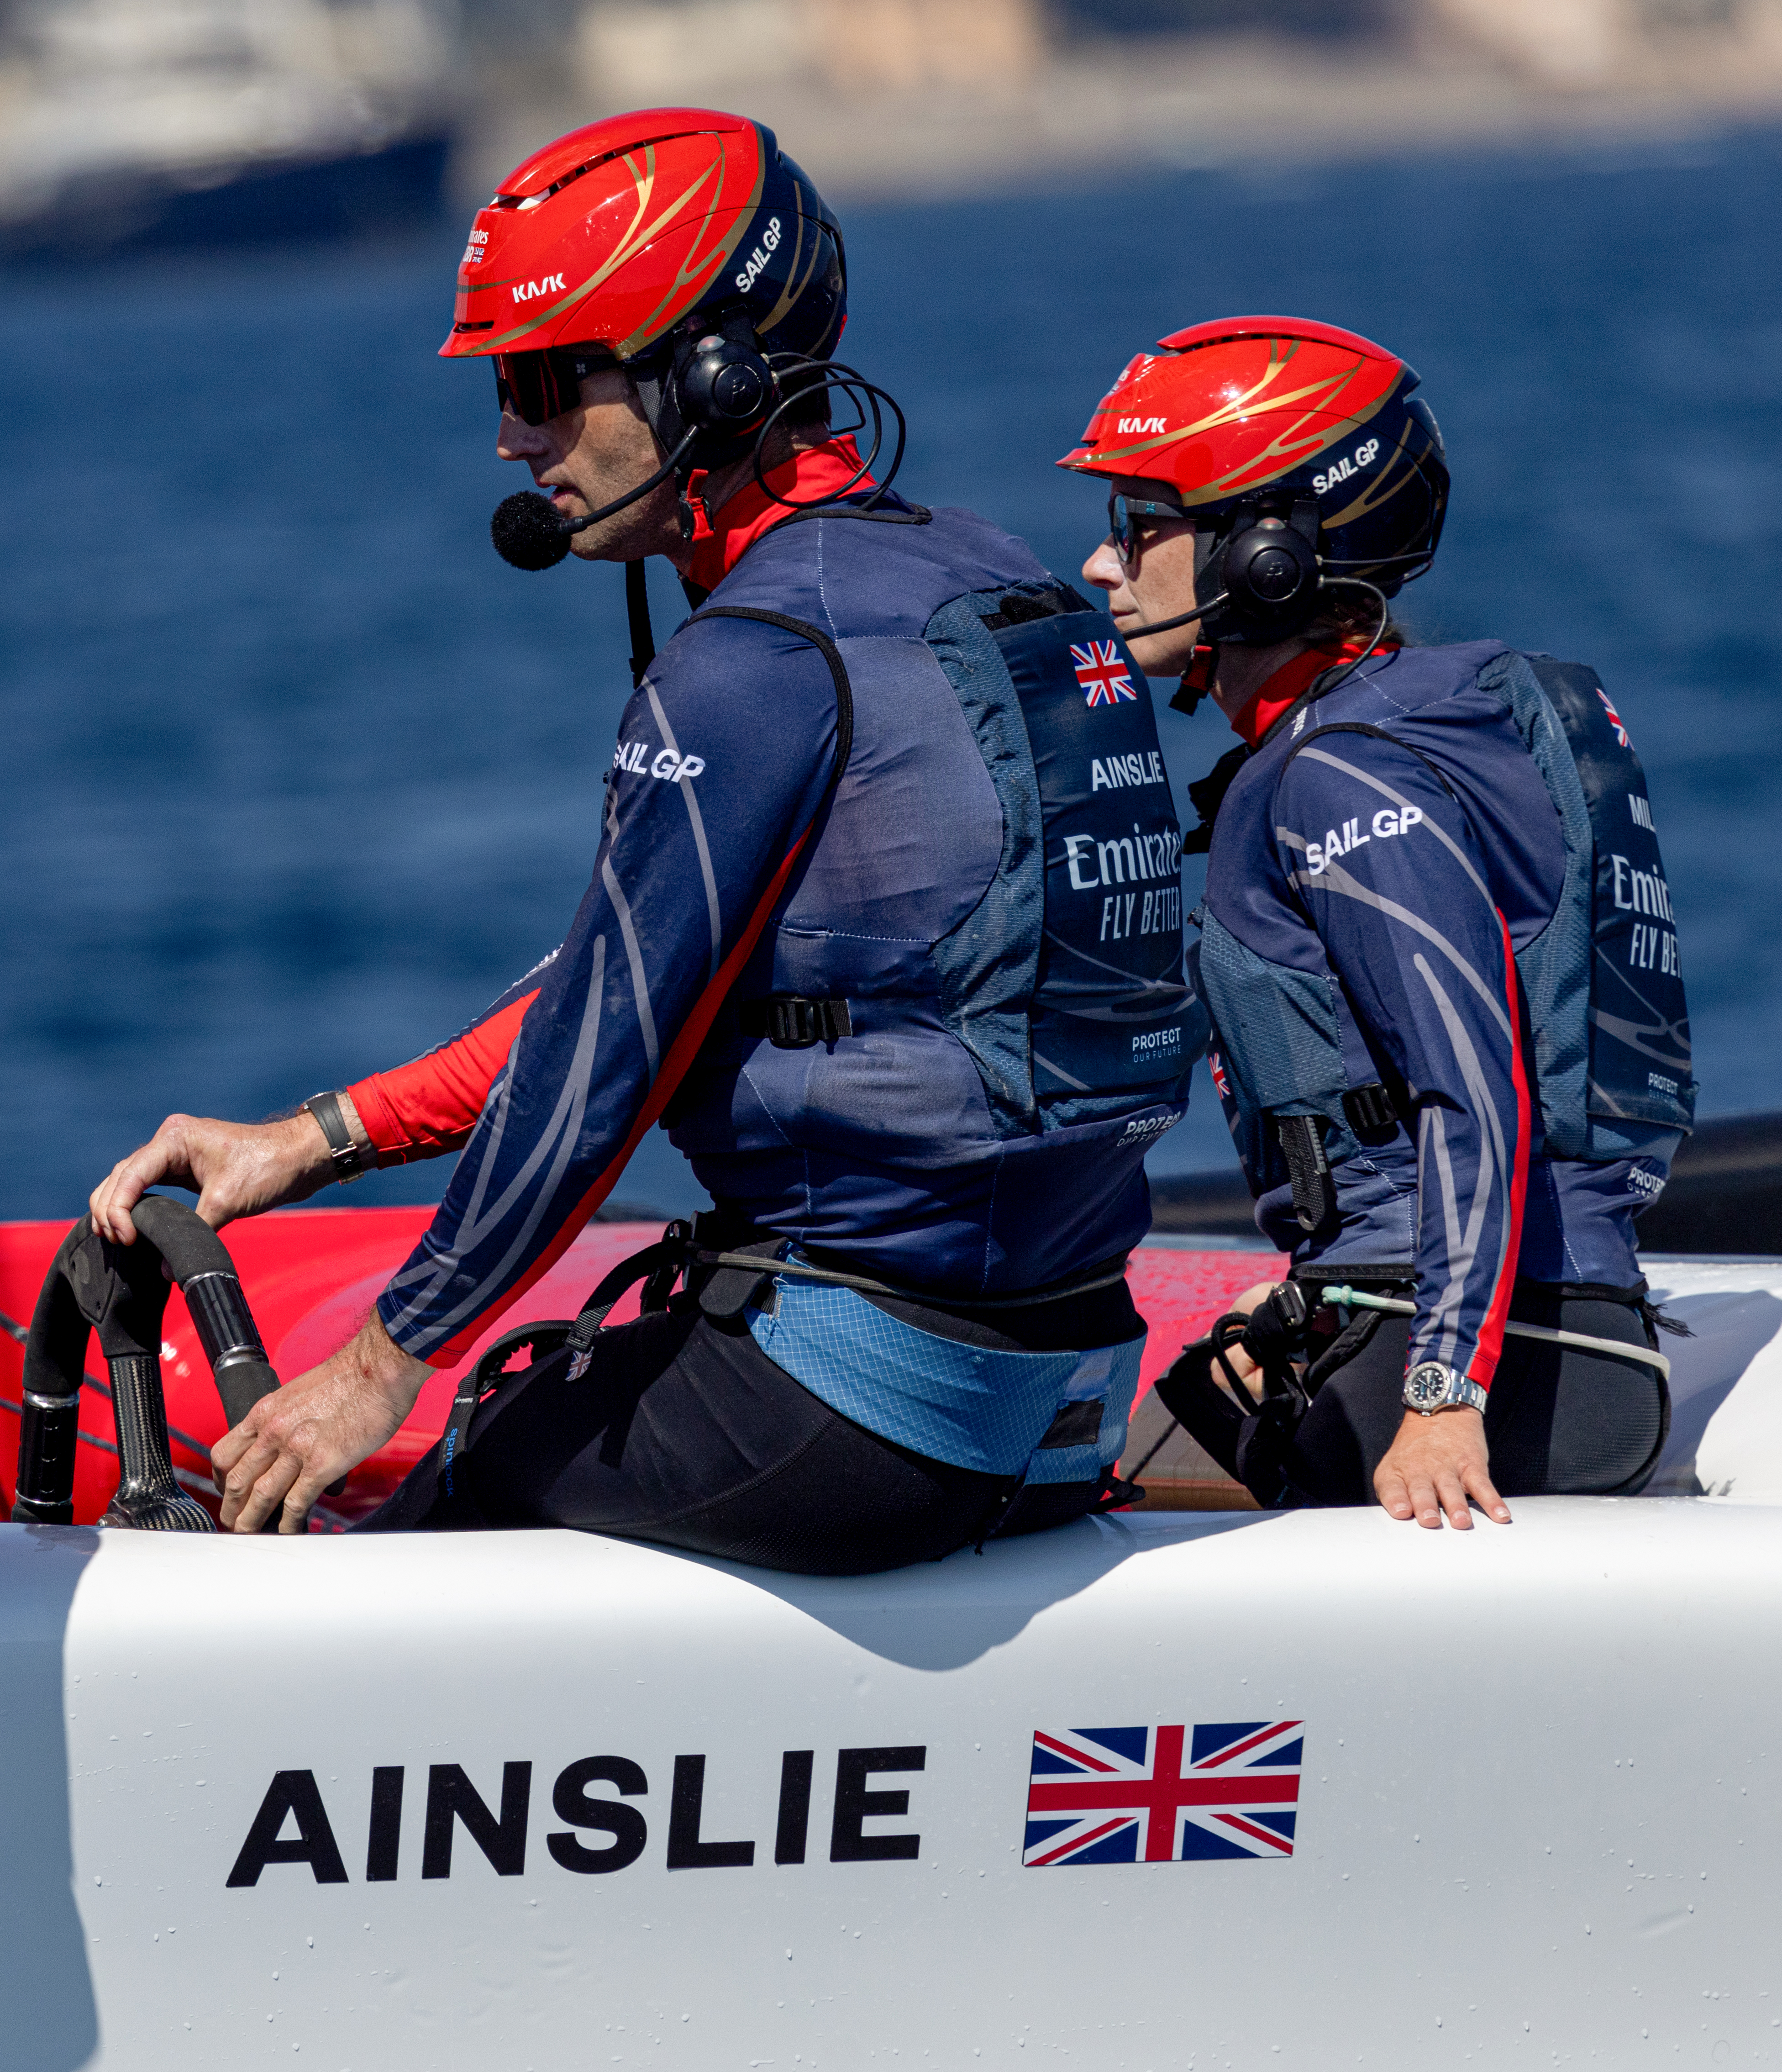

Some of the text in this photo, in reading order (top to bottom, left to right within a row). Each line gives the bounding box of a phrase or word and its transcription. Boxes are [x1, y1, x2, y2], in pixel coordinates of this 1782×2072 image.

[462, 246, 474, 263] BR
[512, 273, 567, 303] KASK
[1117, 417, 1167, 433] KASK
[1092, 752, 1164, 791] AINSLIE
[1063, 823, 1181, 890] Emirate
[1100, 893, 1136, 941] FLY
[1630, 923, 1658, 969] FLY
[1132, 1027, 1181, 1051] PROTECT
[1133, 1045, 1182, 1063] OUR FUTURE
[446, 1428, 458, 1497] spinlock
[225, 1745, 927, 1888] AINSLIE
